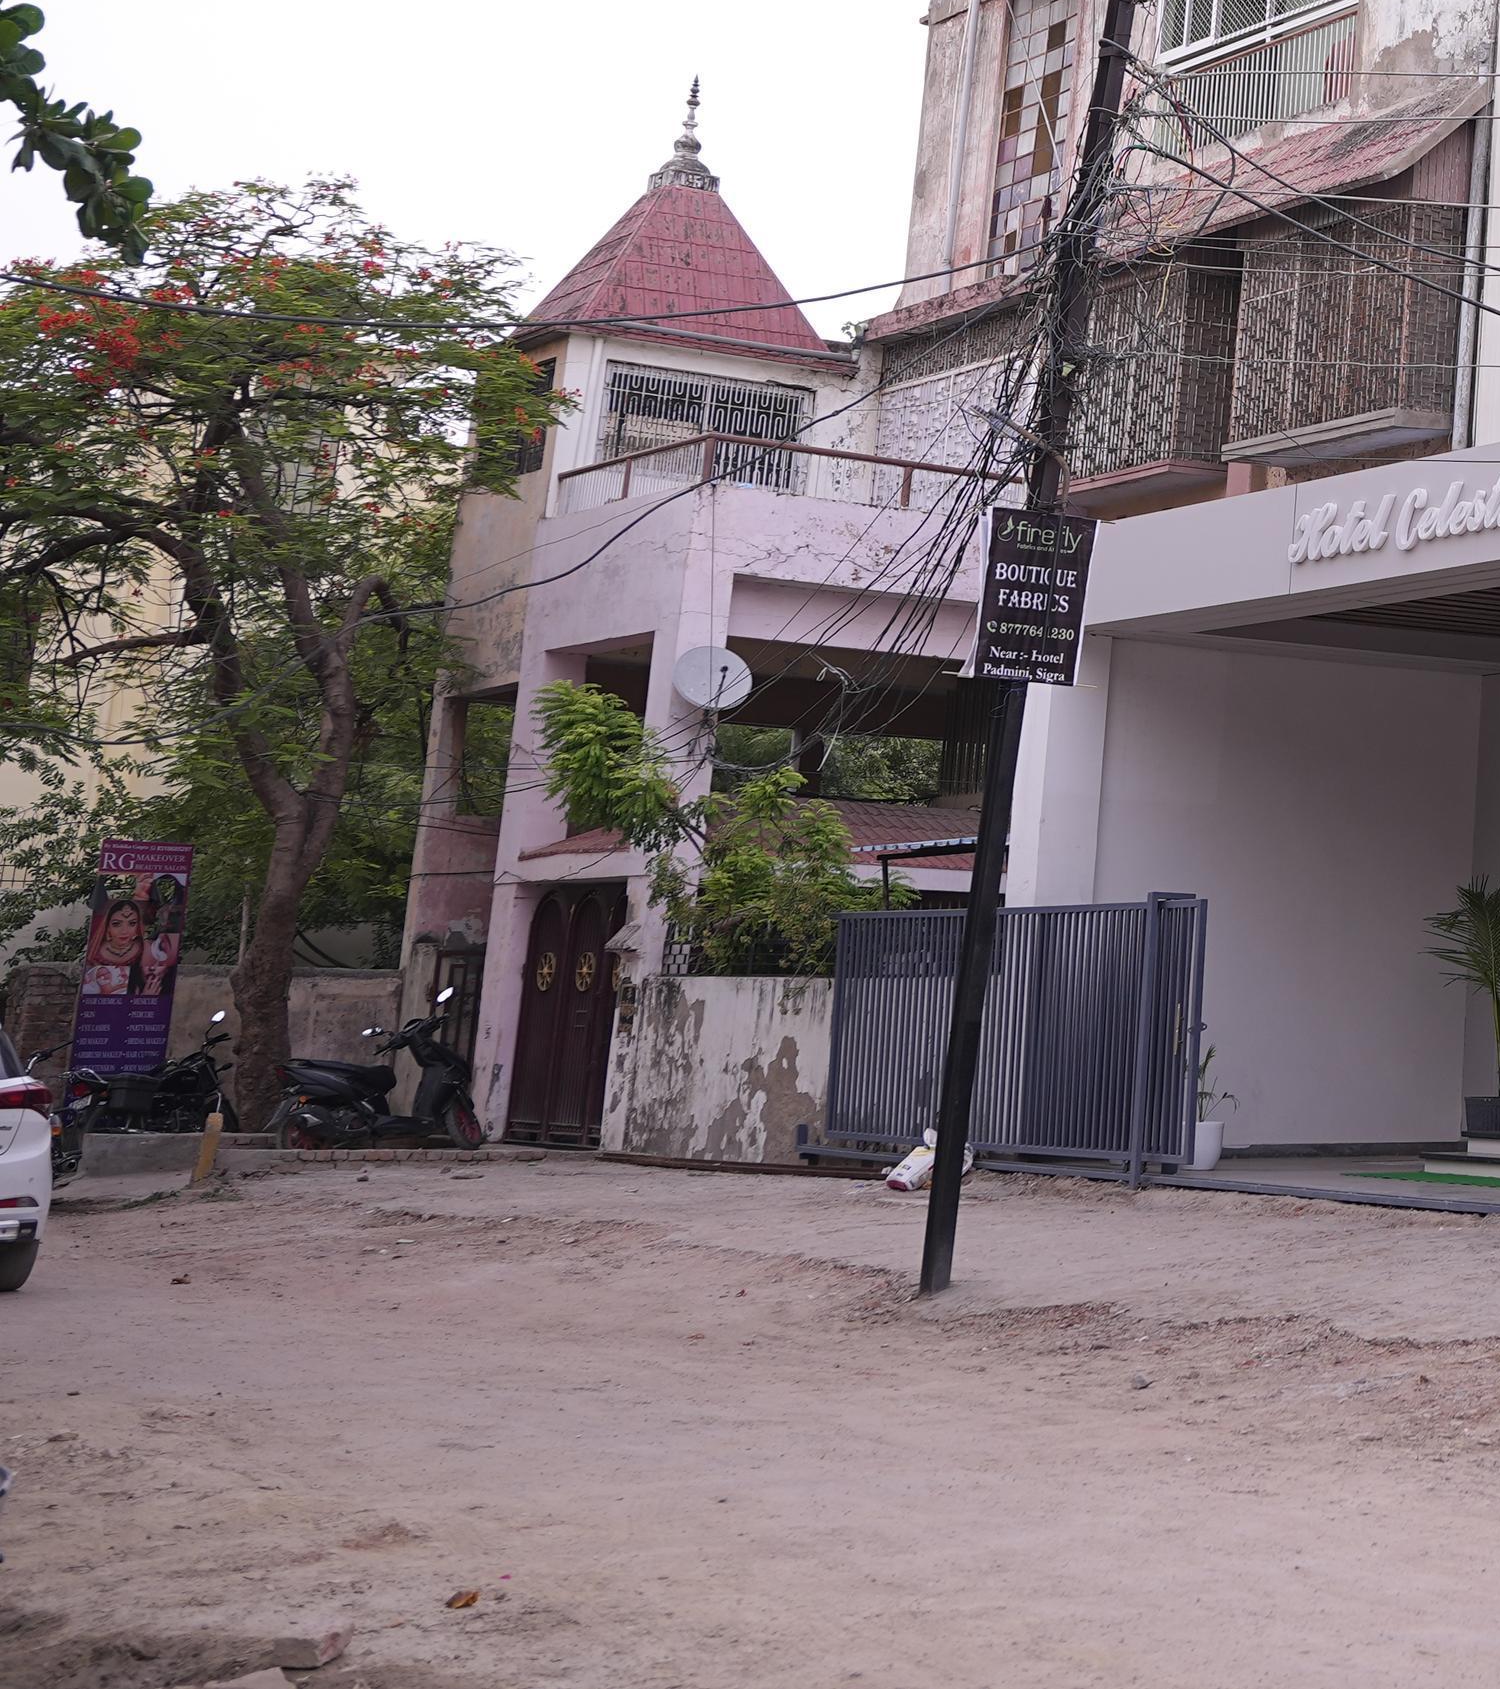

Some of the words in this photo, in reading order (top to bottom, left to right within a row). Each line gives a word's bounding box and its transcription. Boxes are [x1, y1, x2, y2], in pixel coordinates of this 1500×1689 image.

[1288, 493, 1397, 563] Hotel
[999, 622, 1075, 641] 877764230
[989, 645, 1018, 660] Near
[982, 663, 1033, 681] Padmini,
[1035, 667, 1065, 683] Sigra
[102, 852, 136, 871] RG
[135, 853, 186, 862] MAKEOVER
